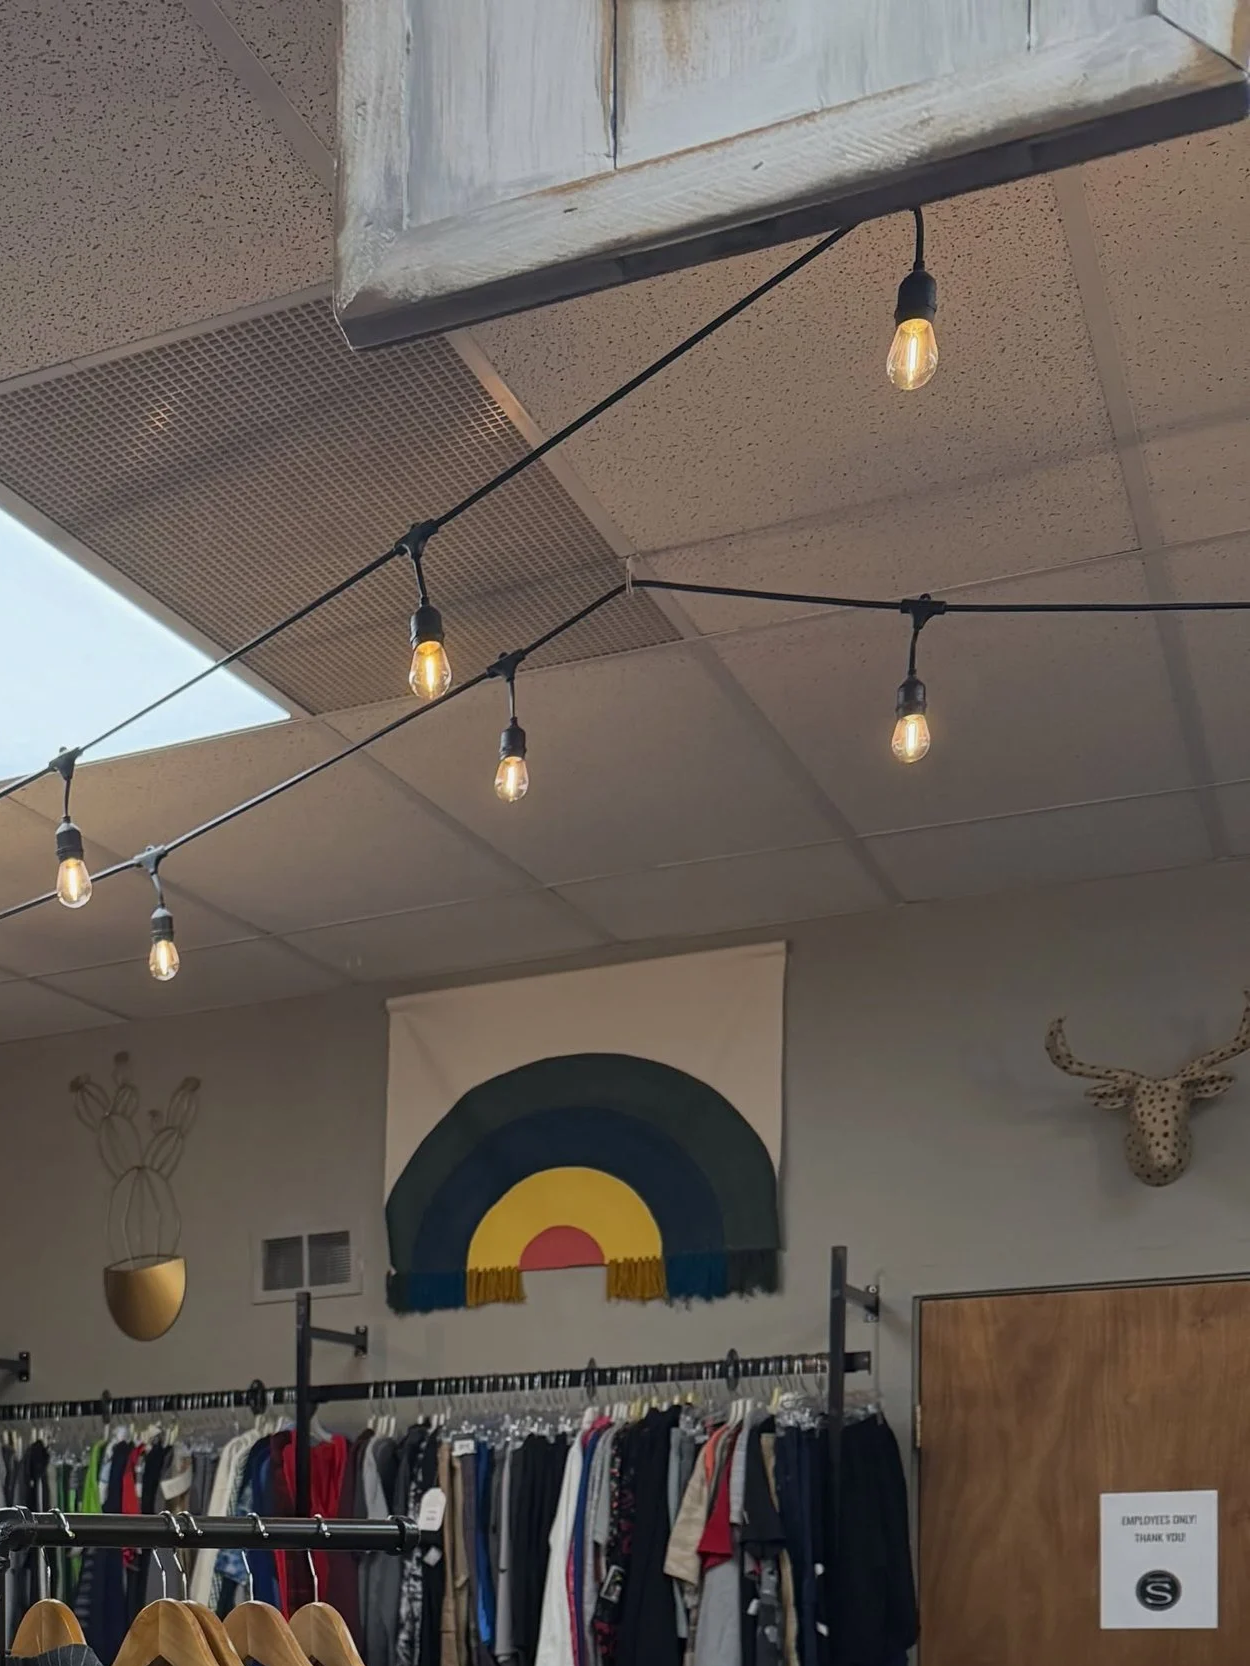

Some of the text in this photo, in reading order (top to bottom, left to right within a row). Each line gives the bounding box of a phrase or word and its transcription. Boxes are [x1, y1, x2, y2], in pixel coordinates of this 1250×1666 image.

[1121, 1514, 1197, 1526] EMPLOYEES ONLY!
[1134, 1532, 1164, 1543] THANK
